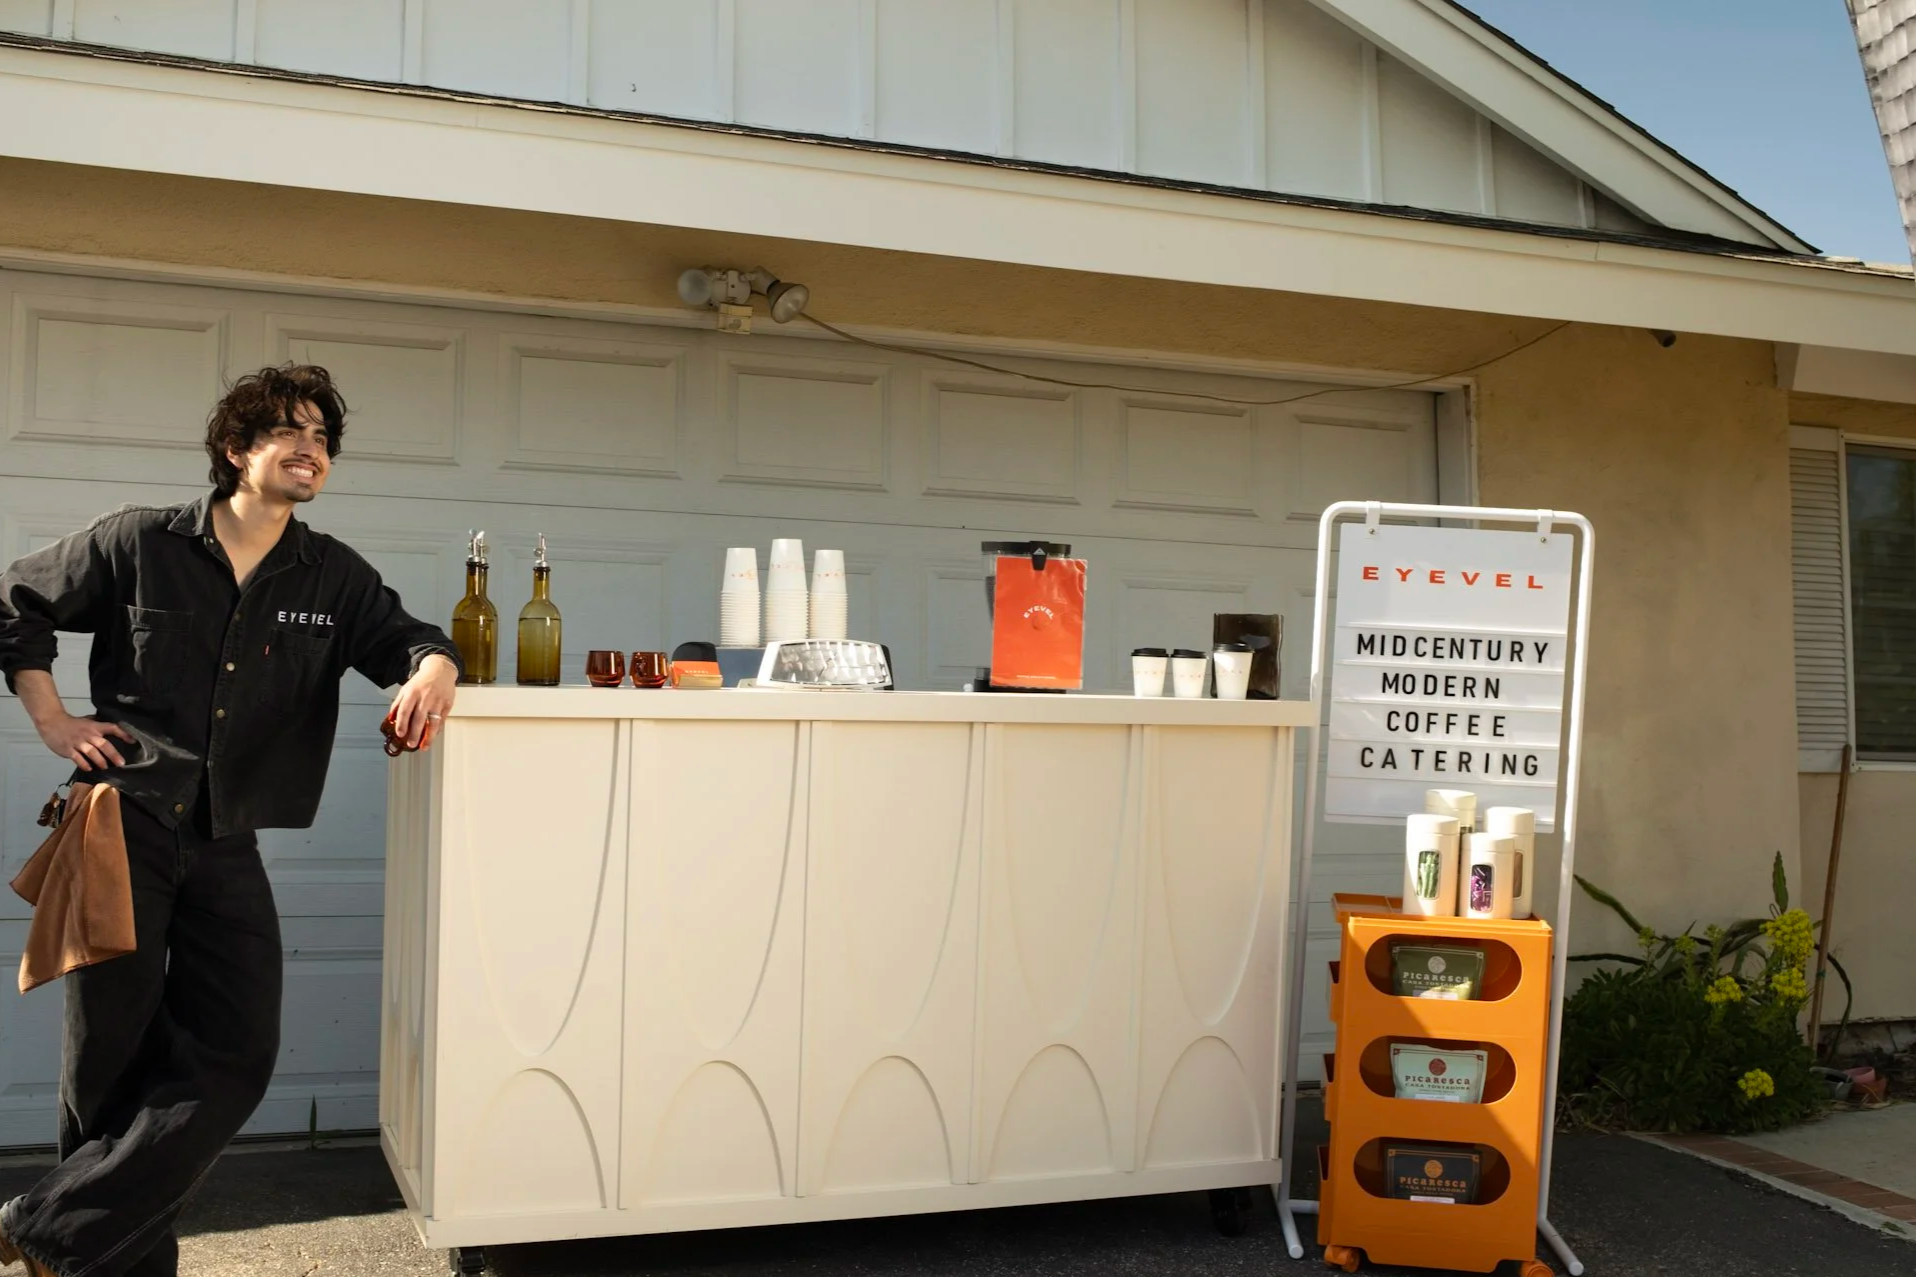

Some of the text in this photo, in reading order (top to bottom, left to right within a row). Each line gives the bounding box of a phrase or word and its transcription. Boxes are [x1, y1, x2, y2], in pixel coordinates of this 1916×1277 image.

[1362, 566, 1543, 589] EYEVEL
[1356, 633, 1549, 664] MIDCENTURY
[1382, 672, 1500, 699] MODERN
[1386, 710, 1506, 737] COFFEE
[1360, 746, 1539, 776] CATERING
